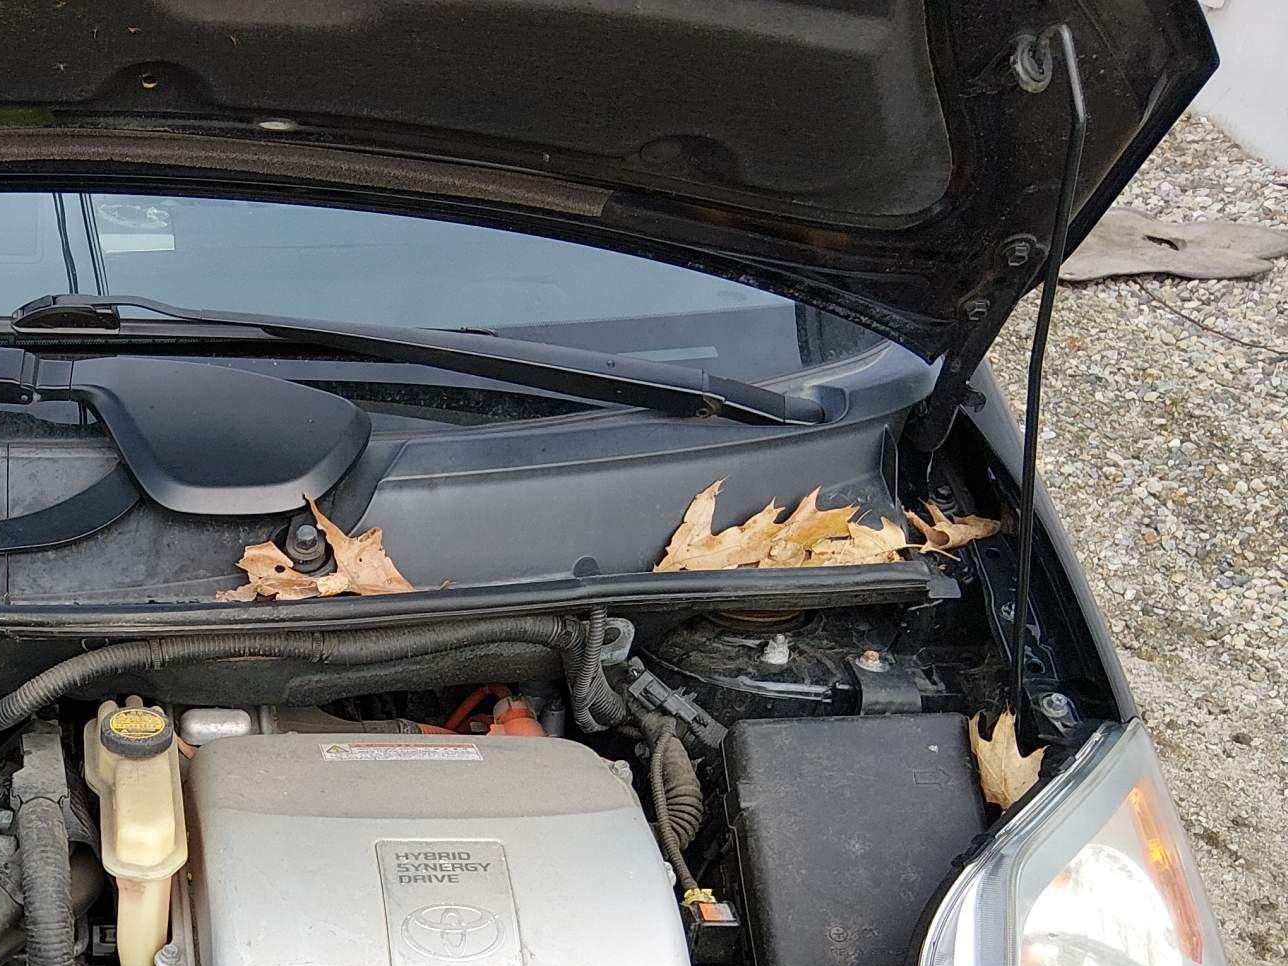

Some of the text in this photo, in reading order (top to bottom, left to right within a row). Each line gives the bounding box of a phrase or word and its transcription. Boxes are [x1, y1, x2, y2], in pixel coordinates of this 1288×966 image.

[395, 851, 471, 861] HYBRID
[396, 863, 491, 872] SYNERGY
[398, 874, 460, 883] DRIVE
